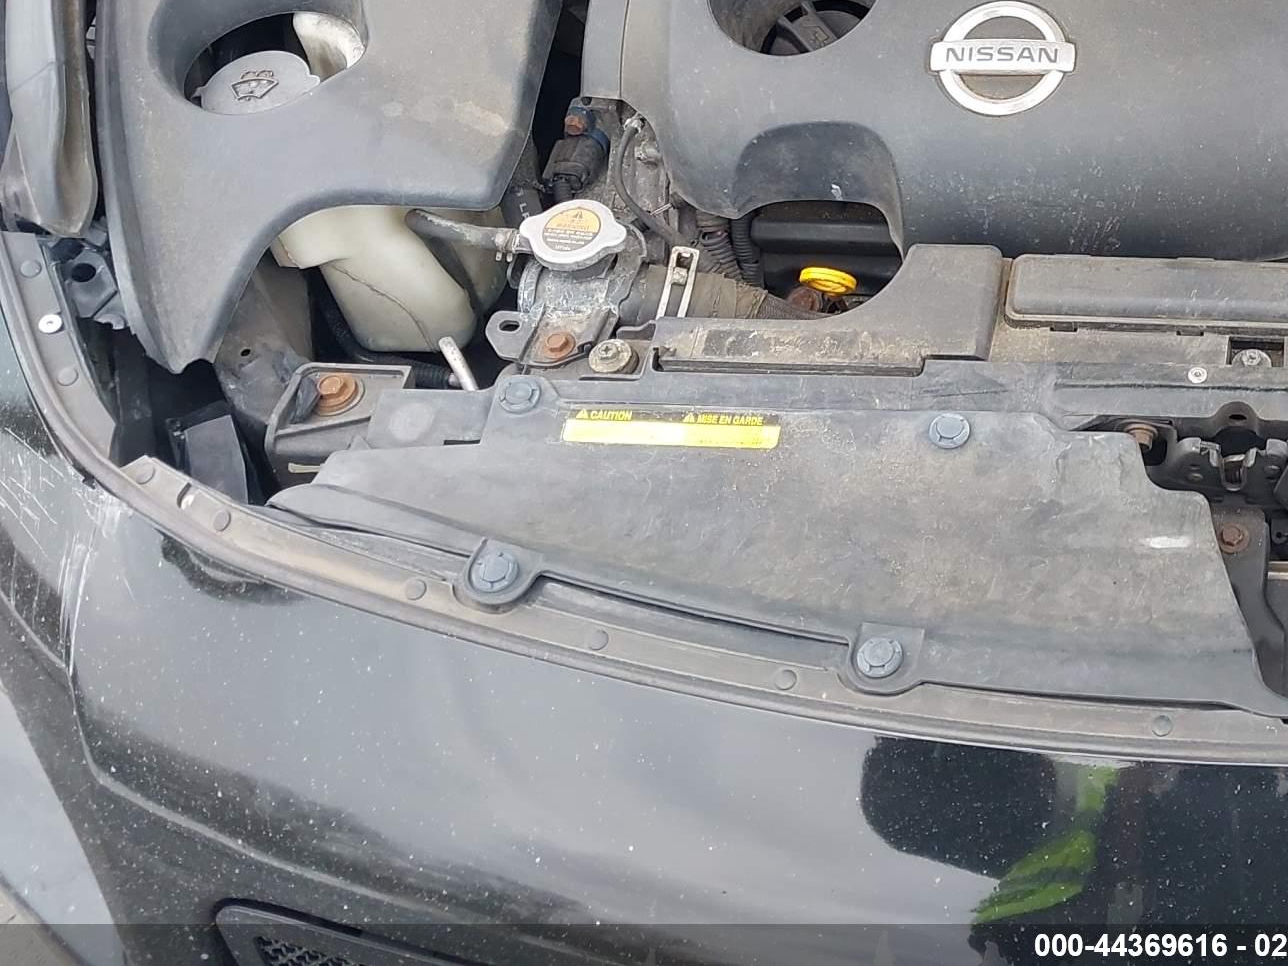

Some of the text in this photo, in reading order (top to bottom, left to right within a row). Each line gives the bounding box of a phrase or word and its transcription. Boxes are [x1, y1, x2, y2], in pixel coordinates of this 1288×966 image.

[946, 46, 1059, 64] NISSAN
[590, 409, 633, 421] CAUTION
[696, 413, 764, 426] MISE EN GARDE
